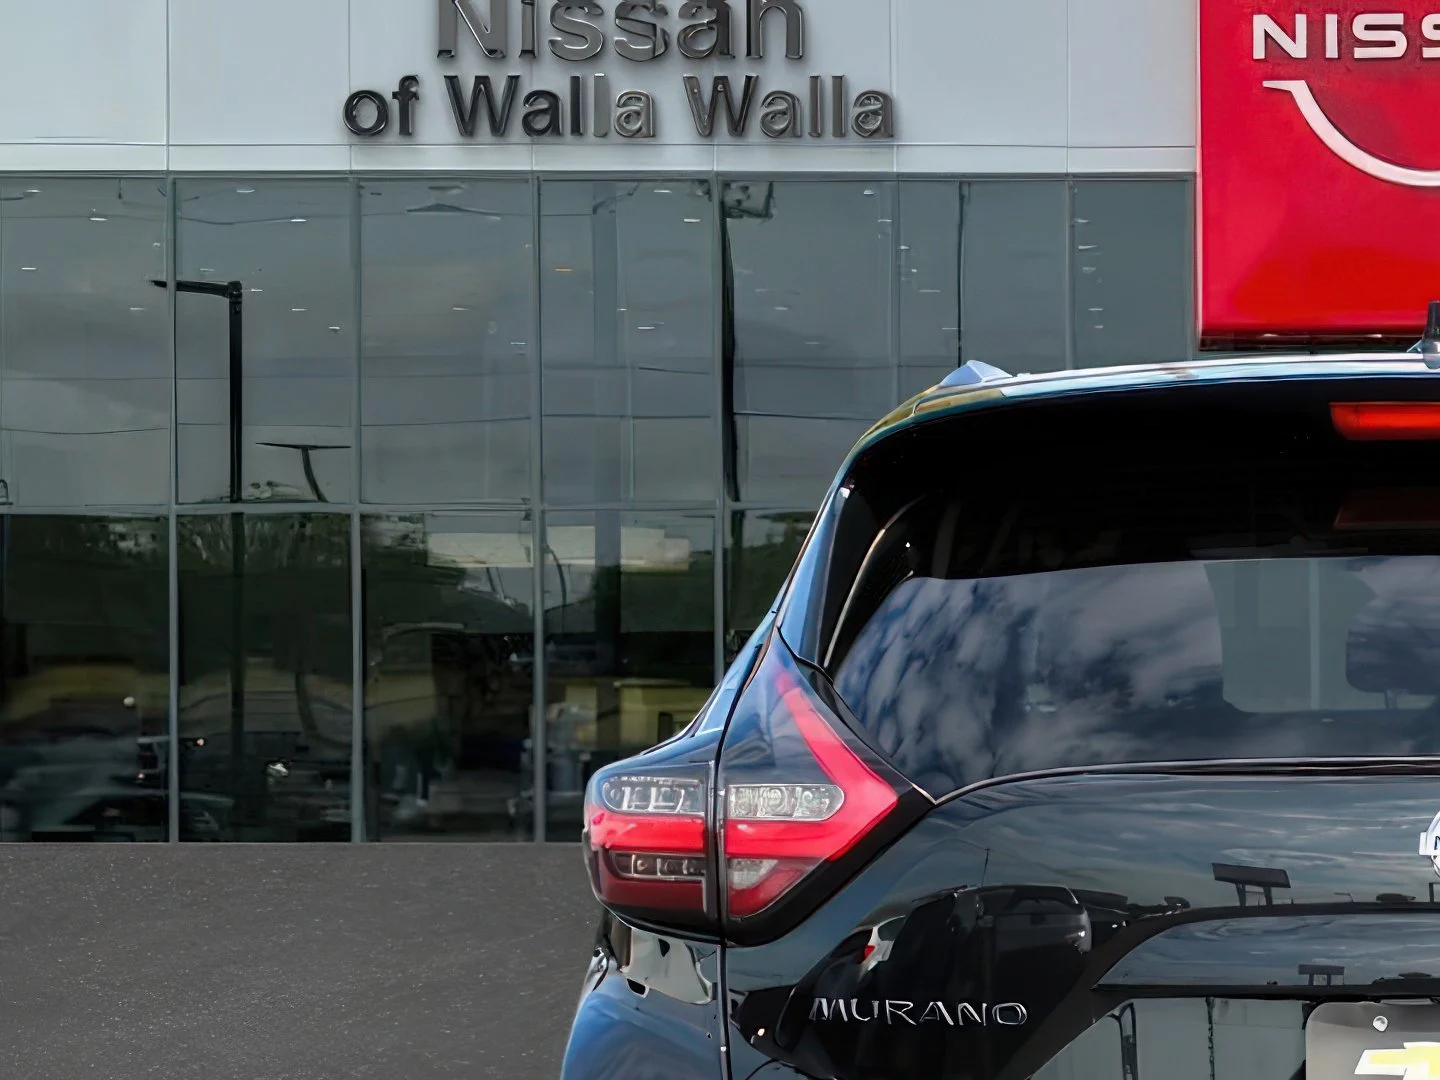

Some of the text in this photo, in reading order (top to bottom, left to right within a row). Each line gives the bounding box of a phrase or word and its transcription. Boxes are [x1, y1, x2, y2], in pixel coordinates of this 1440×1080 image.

[438, 0, 804, 61] Nissan
[343, 74, 893, 138] of Walla Walla
[809, 997, 1028, 1026] MURANO
